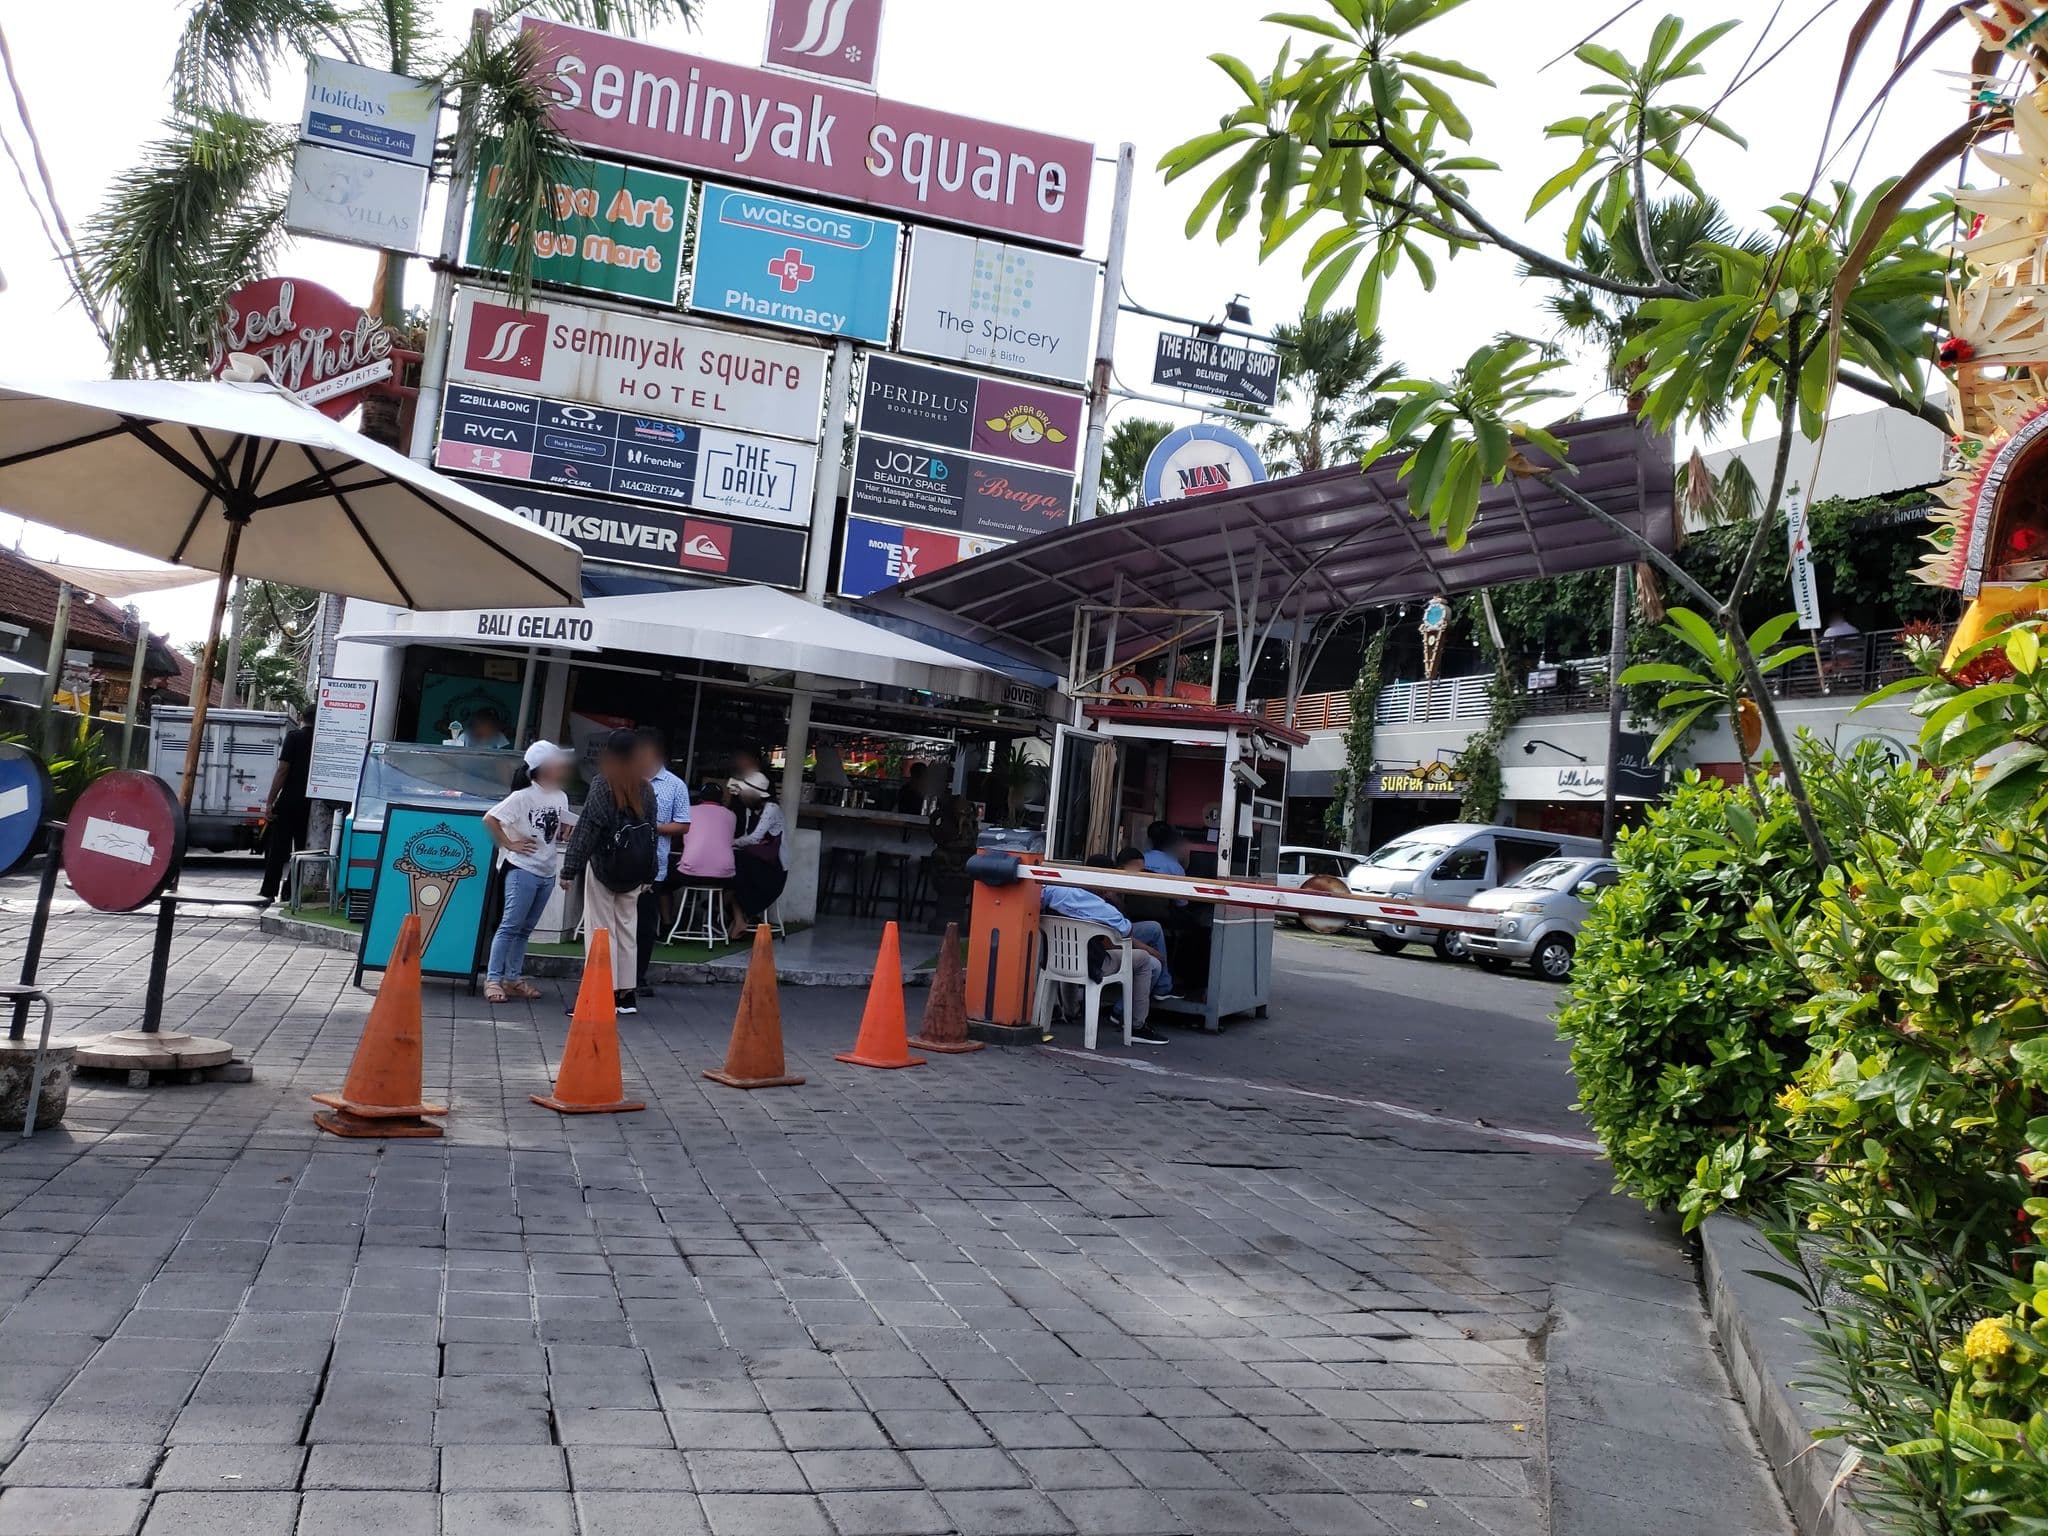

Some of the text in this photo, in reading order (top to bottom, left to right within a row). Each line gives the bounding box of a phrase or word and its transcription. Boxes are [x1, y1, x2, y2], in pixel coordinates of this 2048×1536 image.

[311, 85, 385, 117] Holidays
[349, 128, 382, 143] Classic
[385, 136, 410, 150] Lofts
[551, 54, 1068, 214] seminyak square
[347, 206, 409, 230] VILLAS
[606, 188, 673, 233] Art
[742, 203, 852, 240] watsons
[583, 235, 662, 273] Mart
[725, 288, 846, 332] Pharmacy
[208, 280, 297, 373] Red
[938, 310, 1060, 354] The Spicery
[255, 315, 392, 391] White
[552, 324, 801, 390] seminyak square
[968, 344, 1026, 365] Deli & Bistro
[1161, 334, 1276, 378] THE FISH & CHIP SHOP
[315, 384, 332, 396] AND
[336, 366, 380, 390] SPIRITS
[1162, 368, 1174, 379] EAT
[1195, 368, 1229, 383] DELIVERY
[619, 377, 727, 412] HOTEL
[870, 381, 969, 414] PERIPLUS
[1240, 378, 1269, 402] TAKE AWAY
[472, 397, 530, 414] BILLABONG
[887, 404, 948, 421] BOOKSTORES
[1035, 410, 1052, 428] GIRL
[464, 422, 519, 443] RVCA
[551, 416, 604, 432] OAKLEY
[643, 453, 682, 470] frenchie
[735, 443, 771, 473] THE
[550, 475, 593, 488] RIP CURL
[619, 479, 674, 496] MACBETH
[722, 466, 778, 498] DAILY
[873, 471, 948, 493] BEAUTY SPACE
[1177, 462, 1231, 490] MAN
[978, 477, 1057, 512] Braga
[977, 518, 1016, 531] Indonesian
[1798, 557, 1812, 620] Heineken
[477, 614, 594, 642] BALI GELATO
[328, 681, 357, 689] WELCOME
[1584, 769, 1605, 786] Lan
